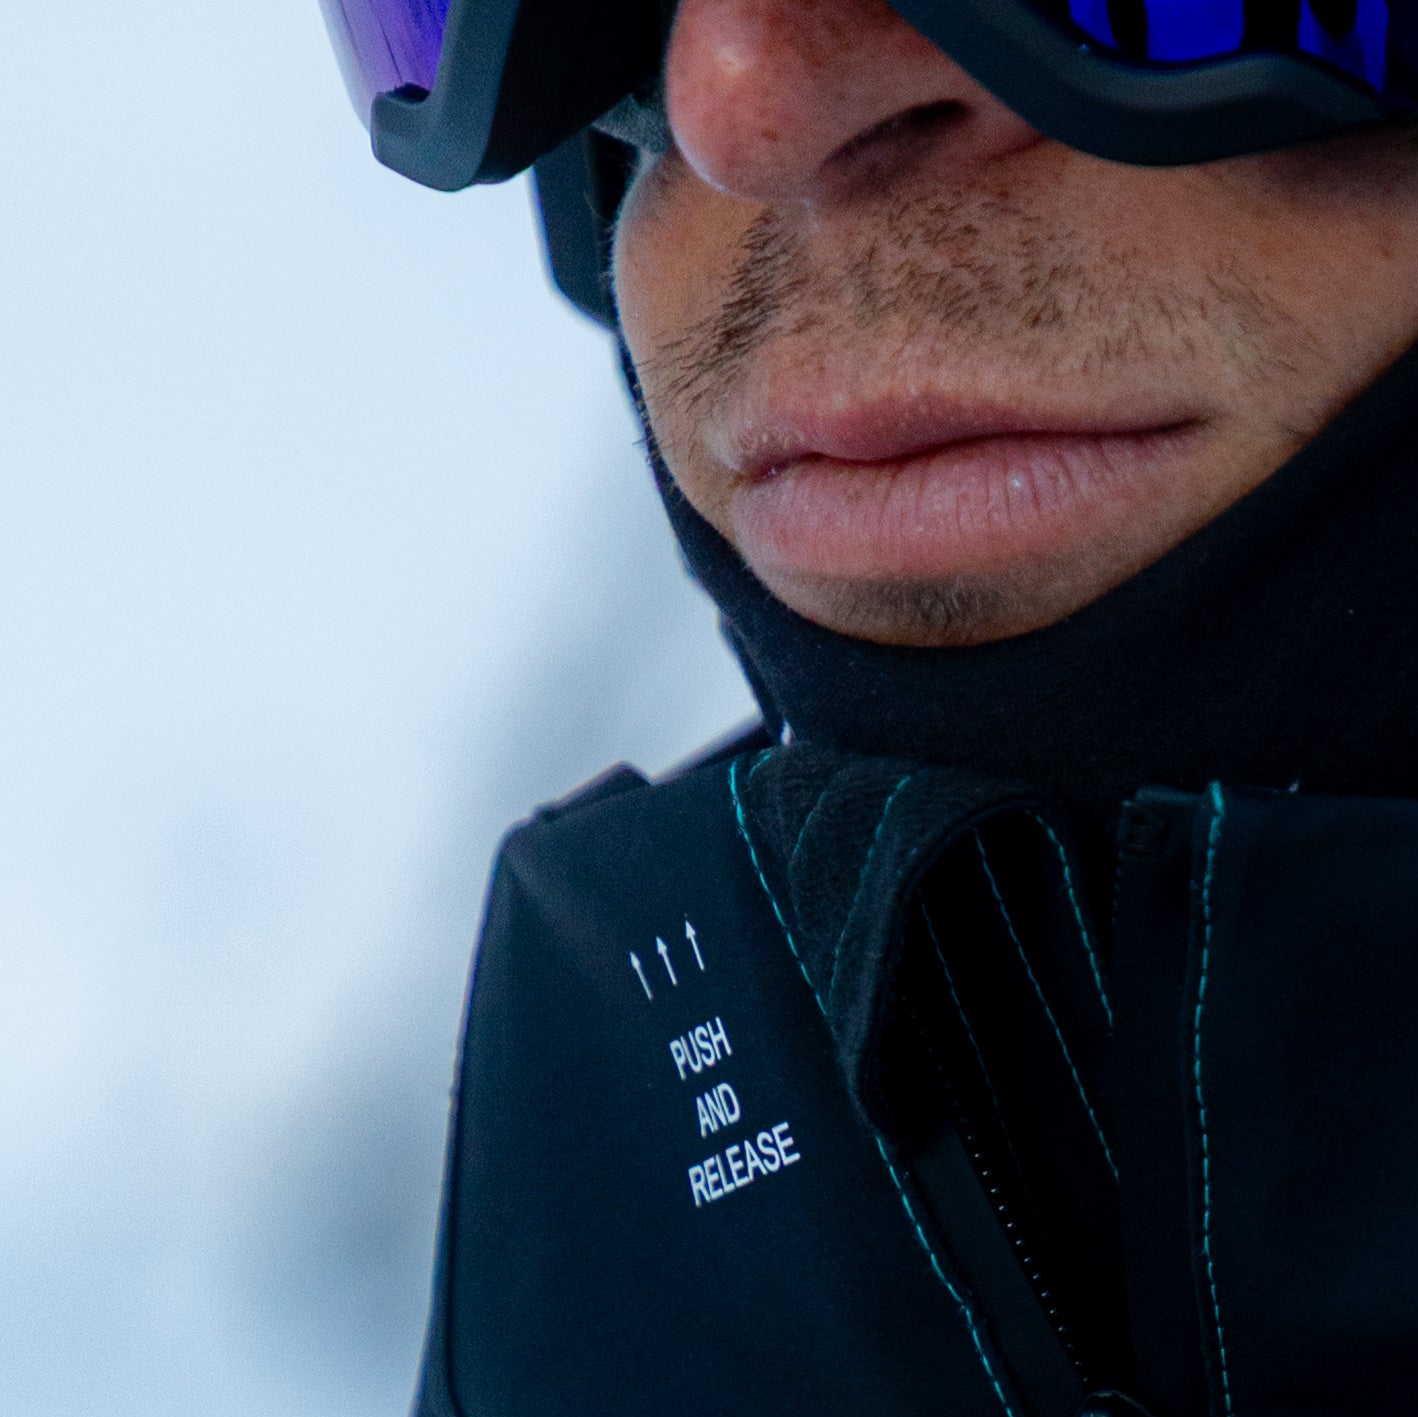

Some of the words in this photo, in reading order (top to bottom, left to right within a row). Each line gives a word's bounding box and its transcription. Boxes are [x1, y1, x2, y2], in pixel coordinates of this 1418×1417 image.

[669, 1016, 732, 1081] PUSH
[696, 1083, 741, 1138] AND
[688, 1121, 800, 1207] RELEASE
